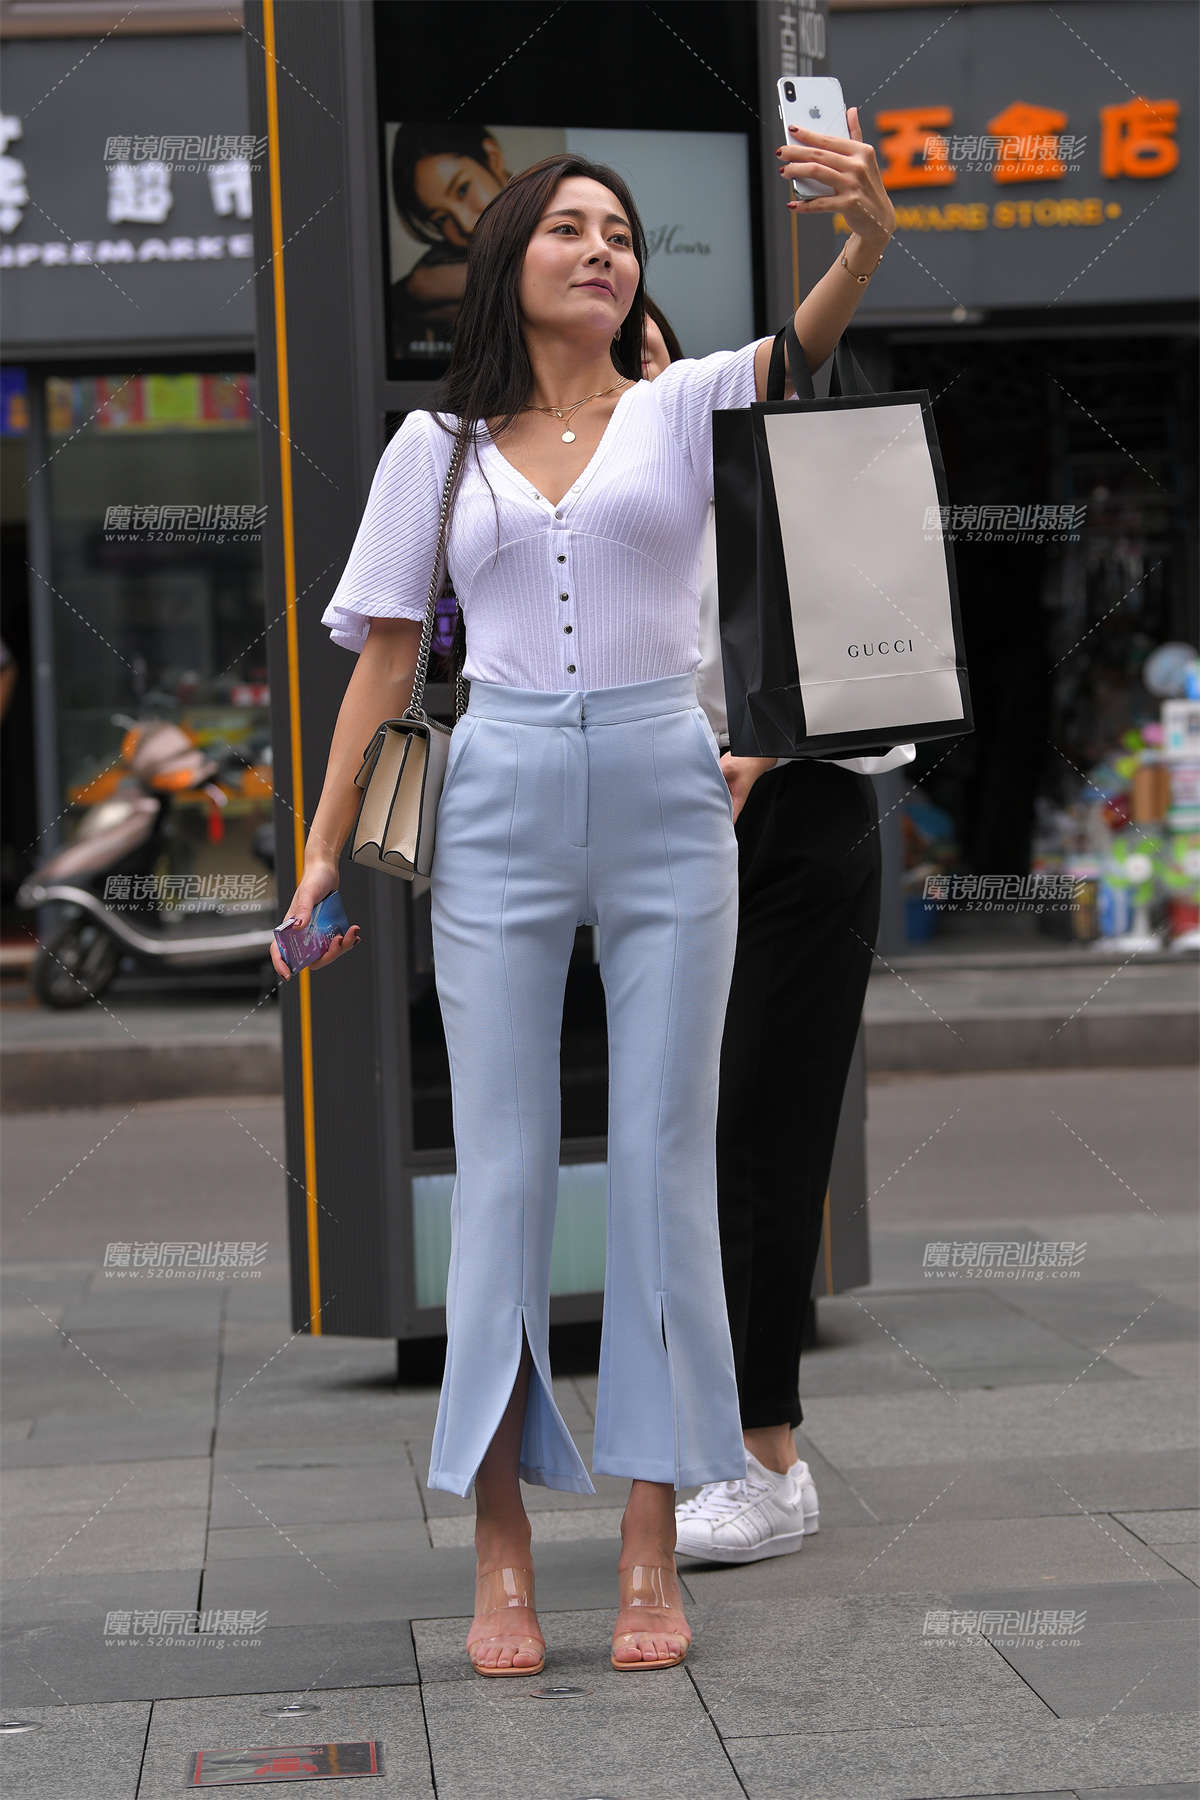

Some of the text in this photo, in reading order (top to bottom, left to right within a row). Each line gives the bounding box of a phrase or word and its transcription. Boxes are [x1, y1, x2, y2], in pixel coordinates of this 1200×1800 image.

[876, 97, 1181, 190] 五金店
[993, 199, 1105, 228] STORE
[847, 639, 913, 658] GUCCI
